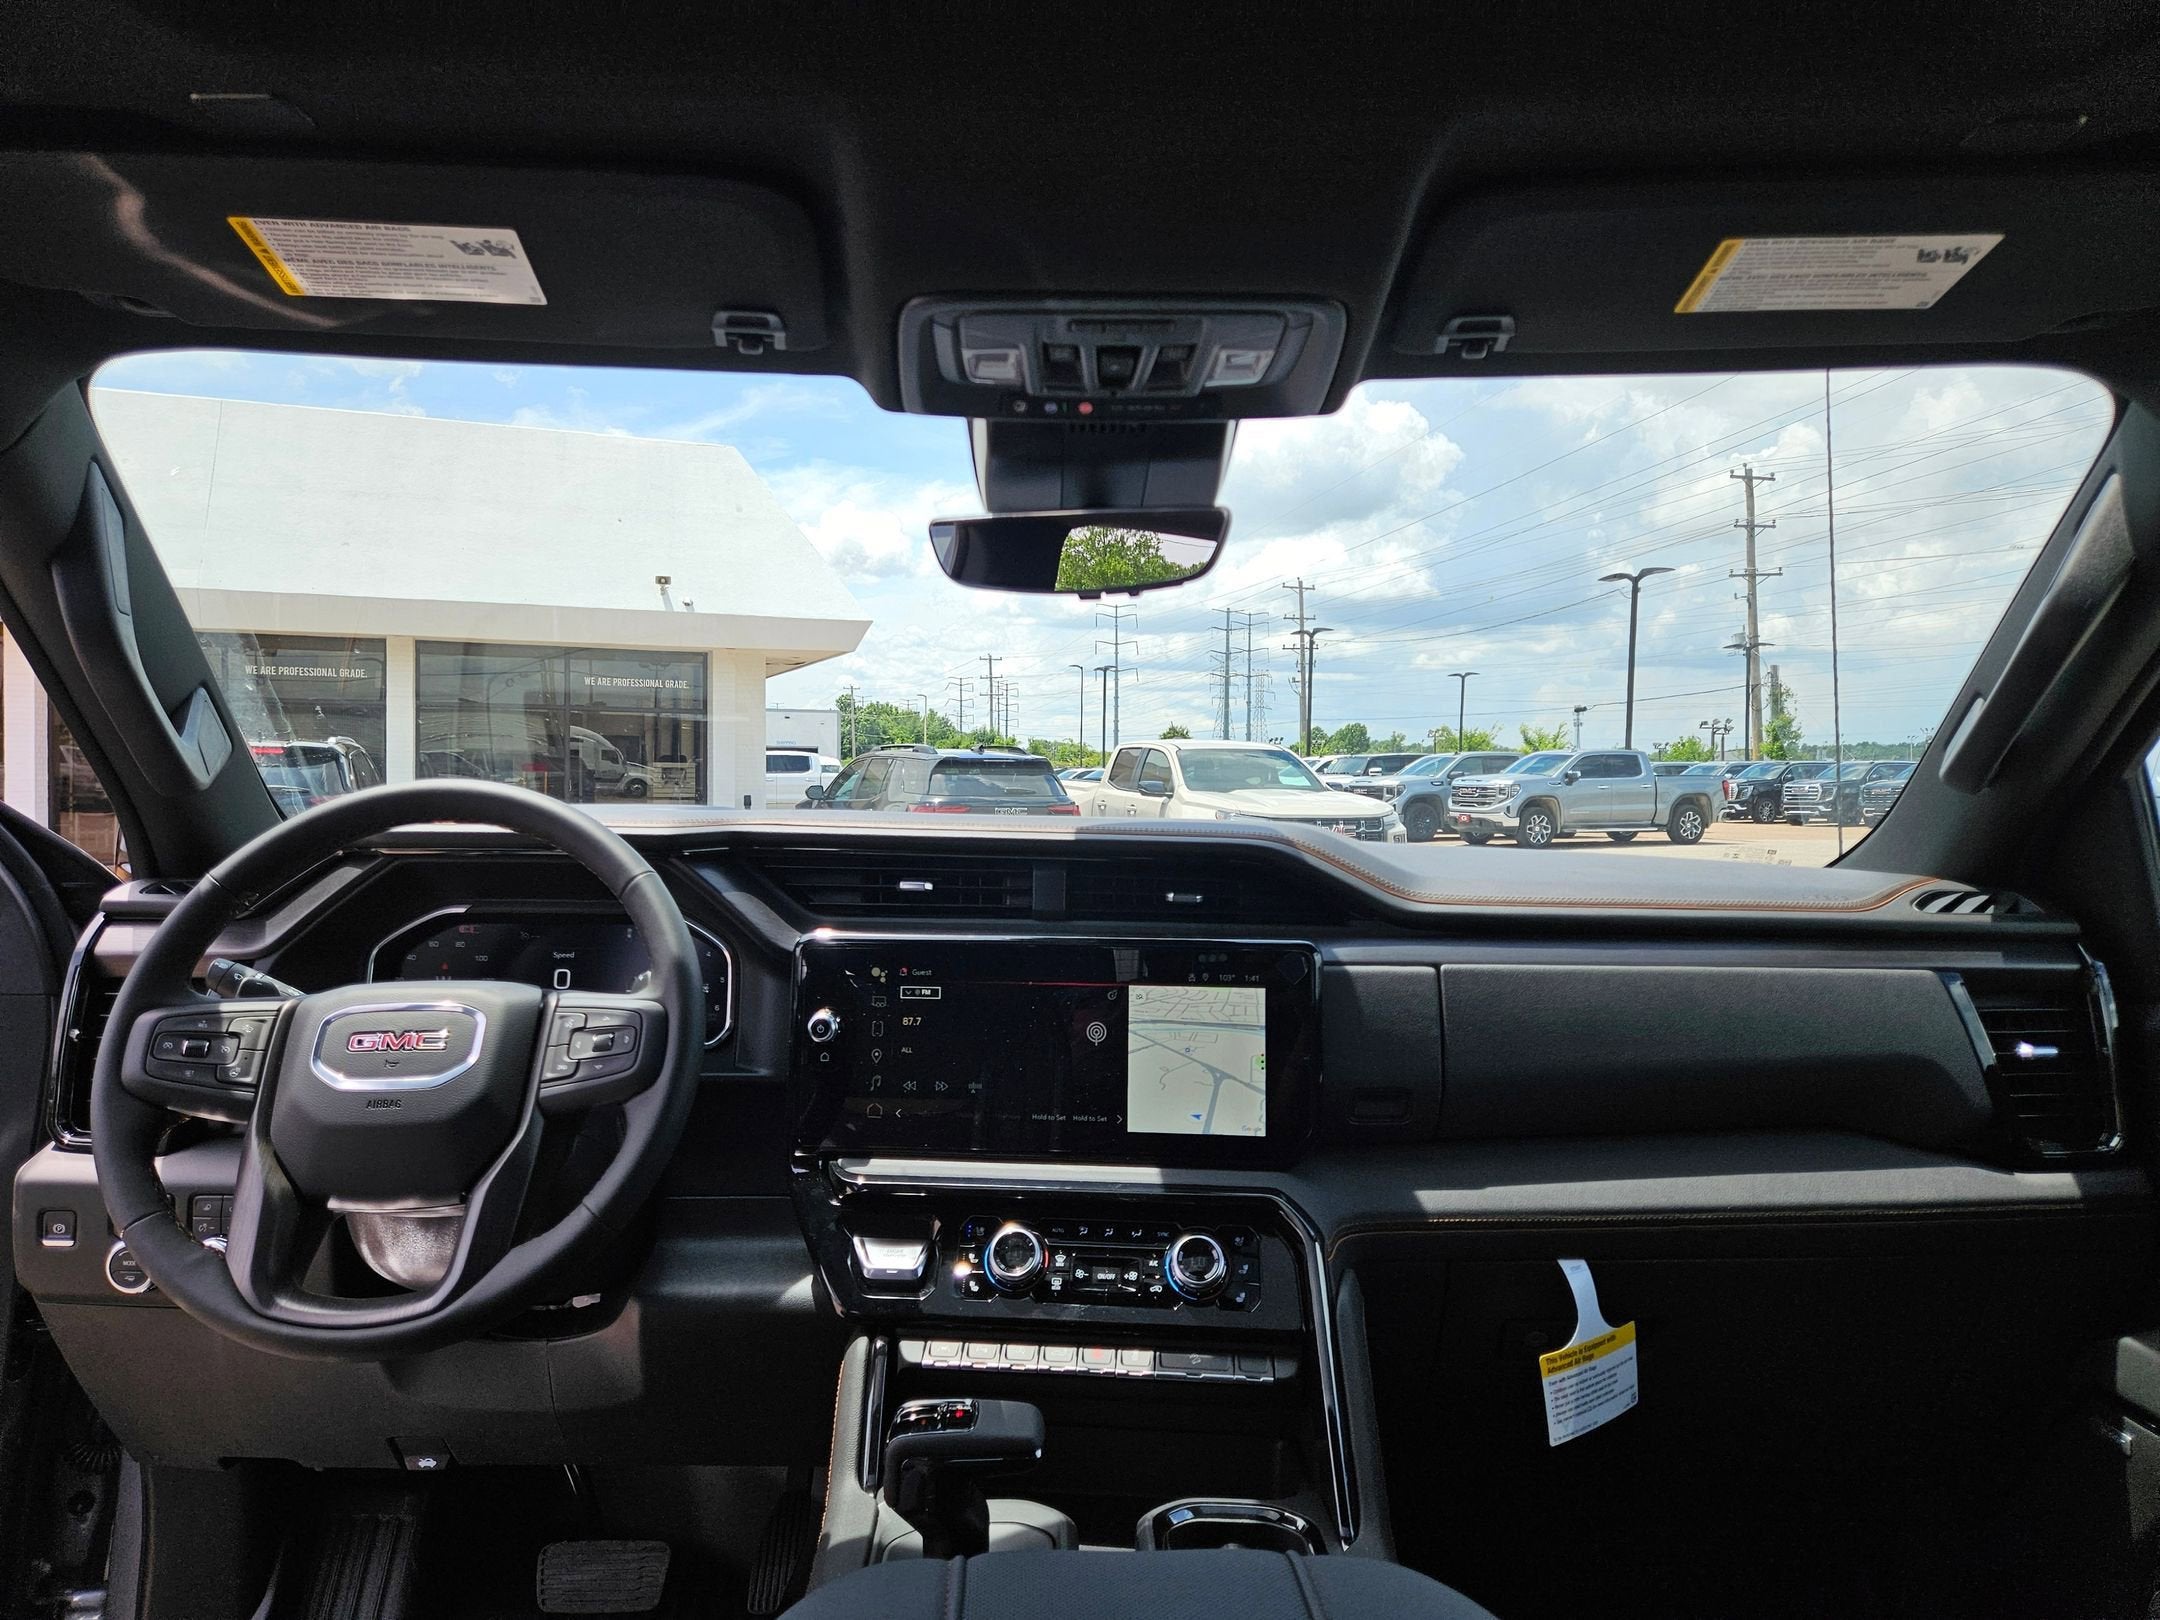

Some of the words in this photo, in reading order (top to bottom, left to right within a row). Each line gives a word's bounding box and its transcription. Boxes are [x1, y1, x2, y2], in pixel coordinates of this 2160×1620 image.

[245, 665, 257, 675] WE
[260, 666, 276, 675] ARE
[278, 666, 337, 677] PROFESSIONAL
[340, 668, 368, 678] GRADE.
[584, 676, 596, 686] WE
[597, 677, 611, 686] ARE
[613, 678, 663, 688] PROFESSIONAL
[902, 1017, 921, 1026] 87.7
[346, 1030, 449, 1052] GMC
[366, 1099, 402, 1110] AIRBAG
